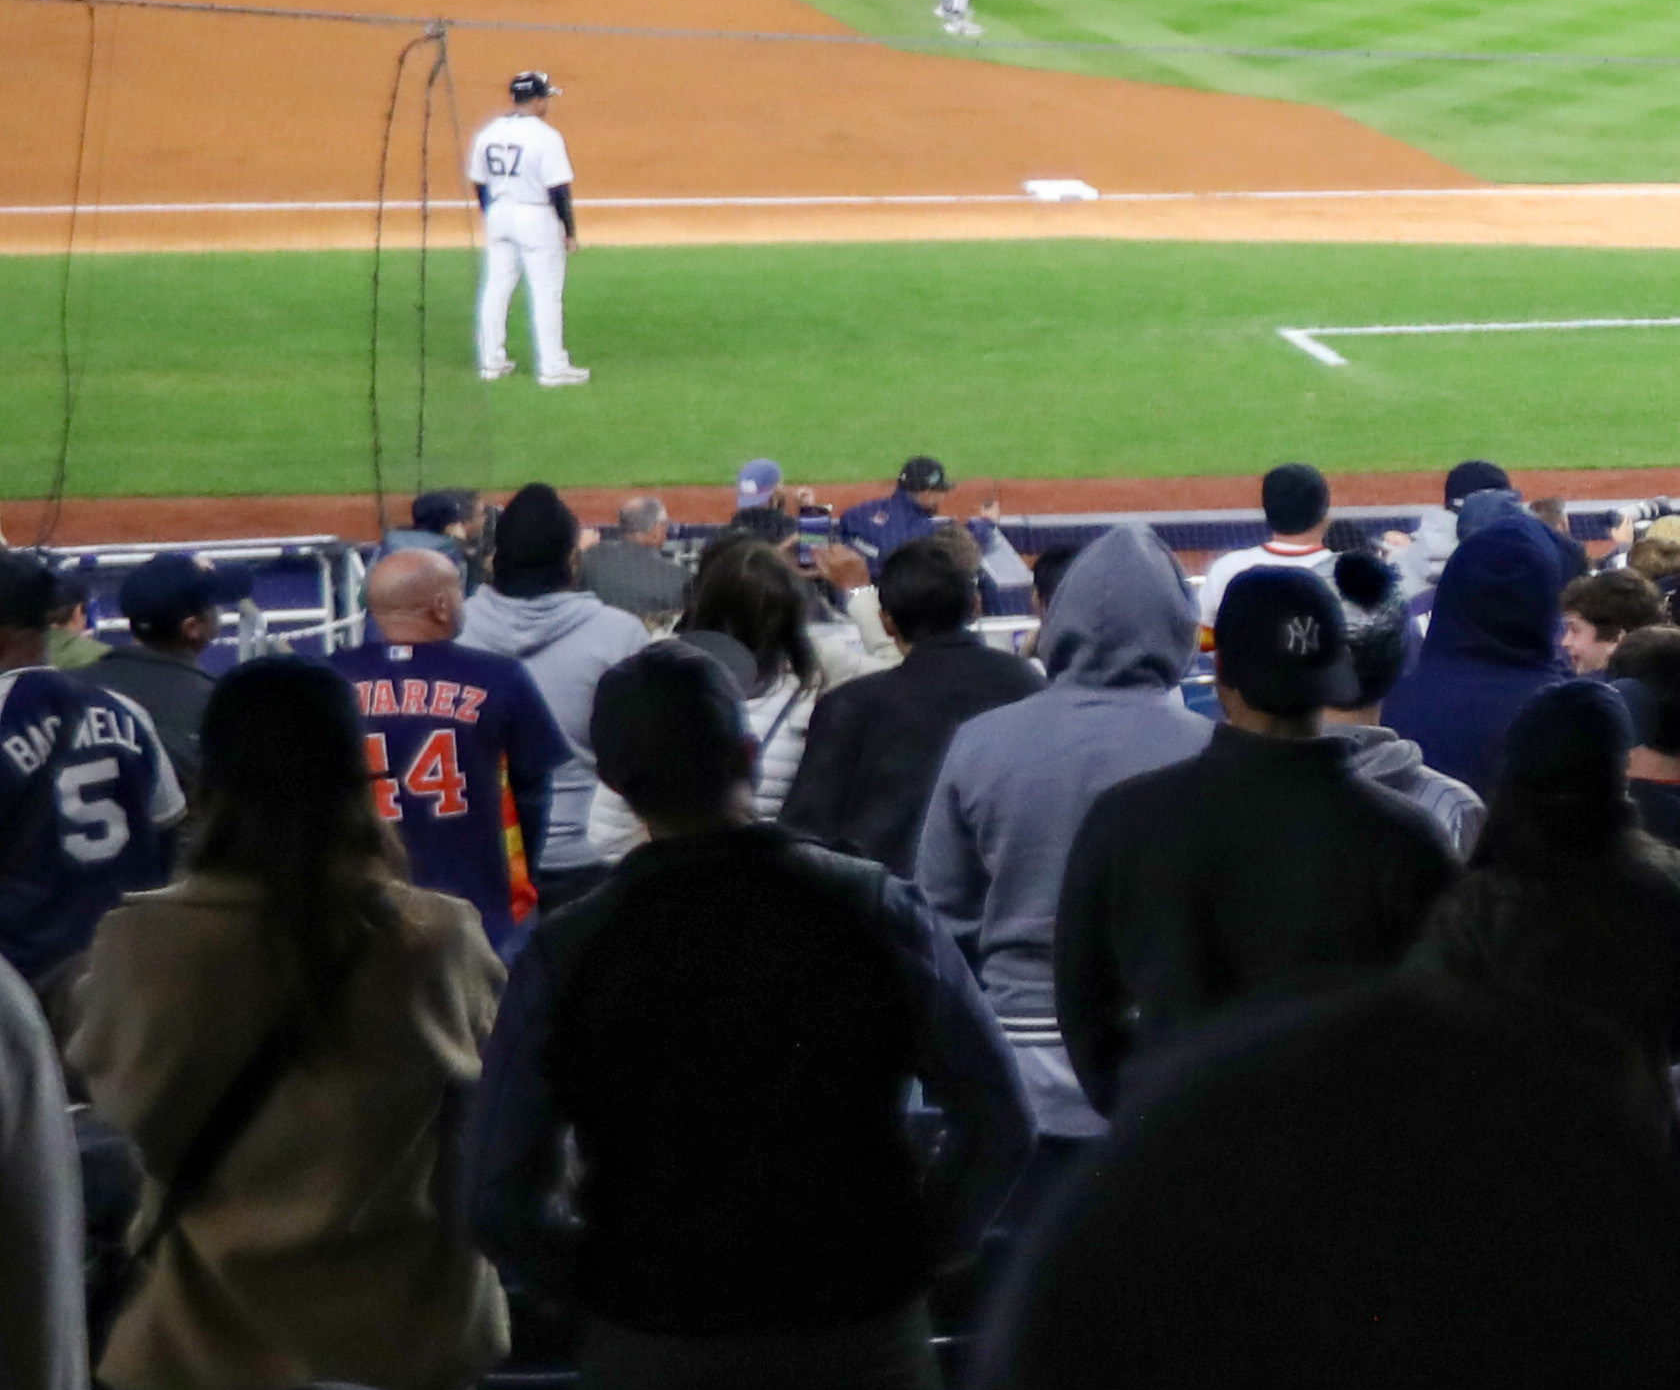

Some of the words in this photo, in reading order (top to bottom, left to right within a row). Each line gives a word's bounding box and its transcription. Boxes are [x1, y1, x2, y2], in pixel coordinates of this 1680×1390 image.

[484, 142, 525, 178] 67
[353, 678, 488, 724] AREZ
[55, 756, 131, 862] 5
